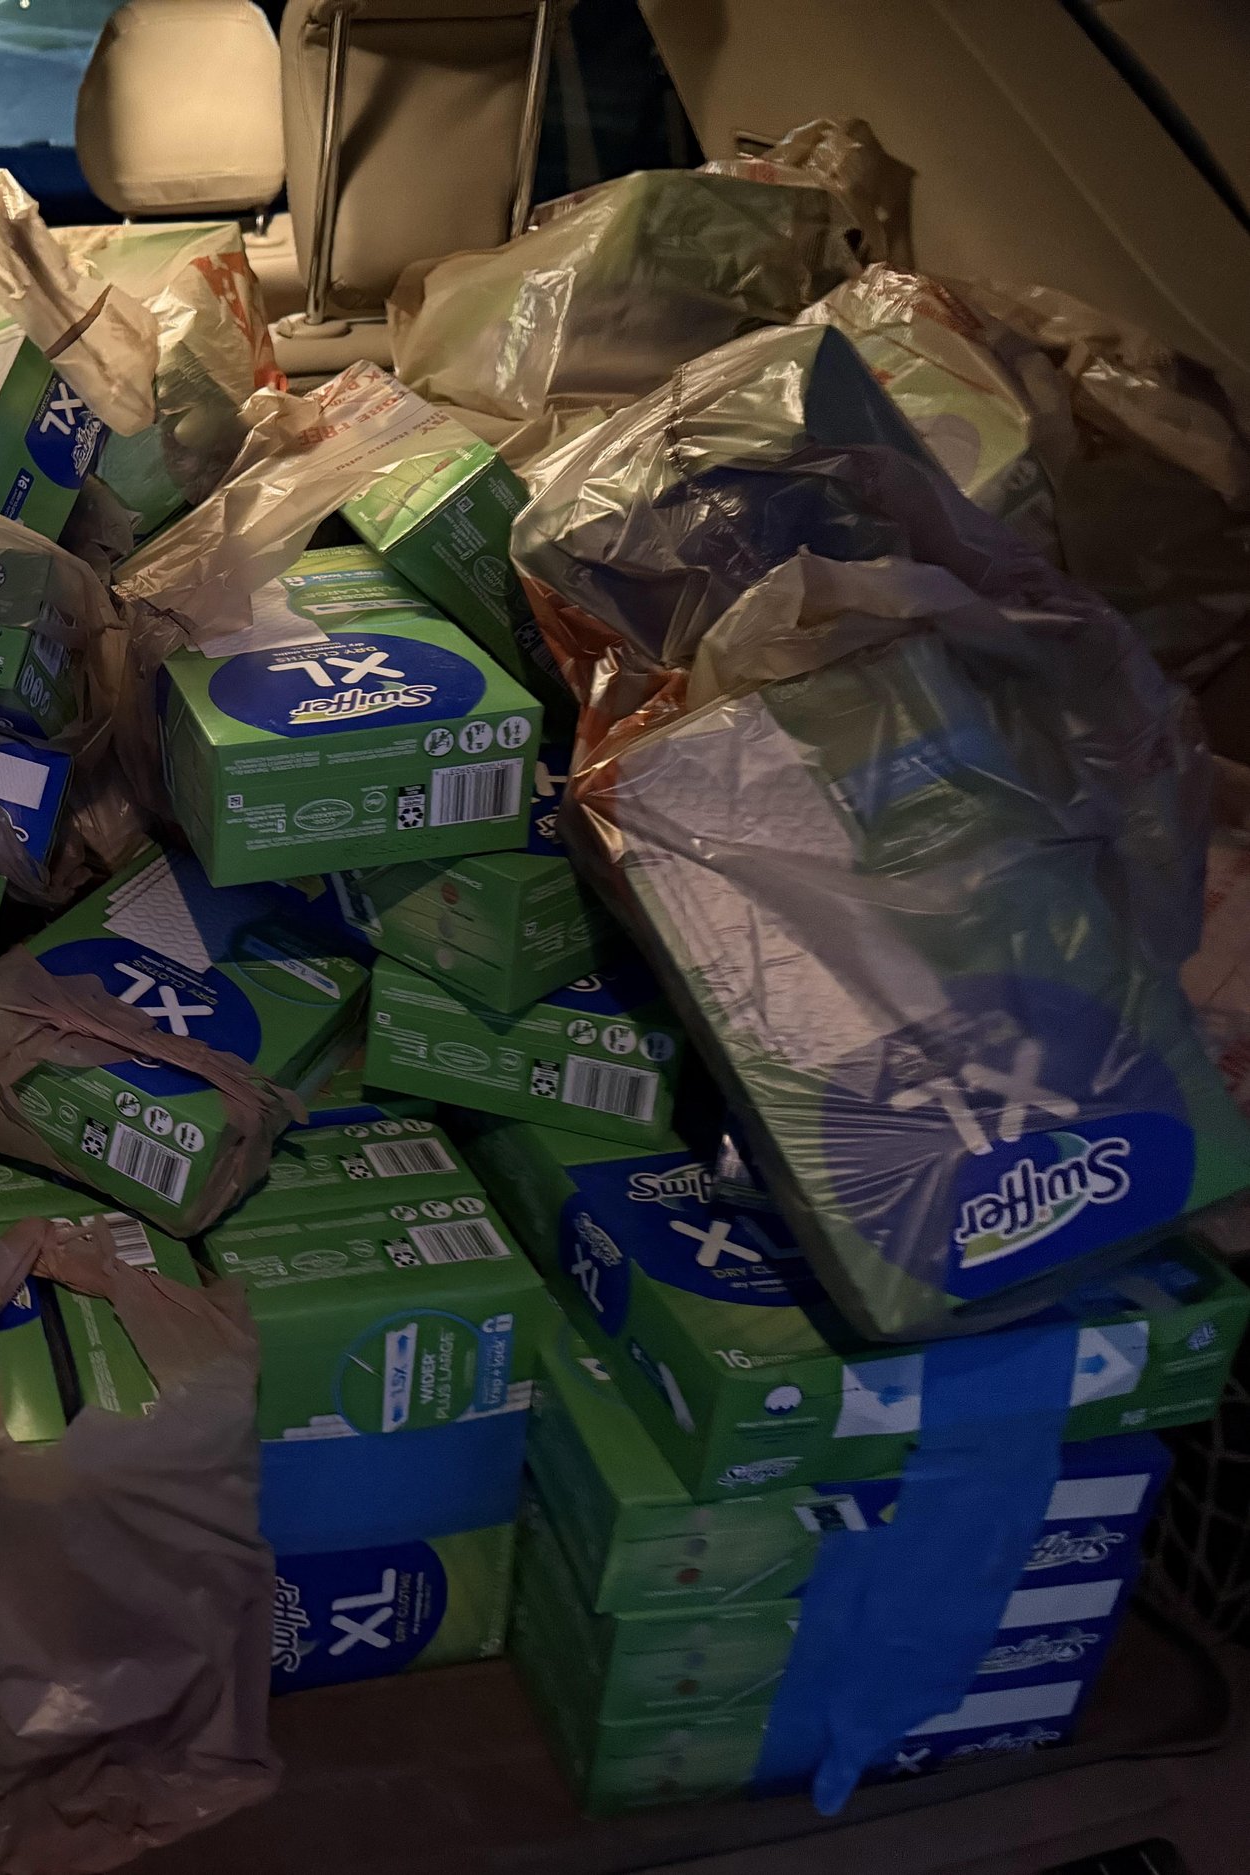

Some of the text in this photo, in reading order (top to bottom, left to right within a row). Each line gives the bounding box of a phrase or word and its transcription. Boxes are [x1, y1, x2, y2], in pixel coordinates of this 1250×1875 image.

[40, 382, 84, 435] XL
[267, 652, 405, 687] XL
[275, 645, 378, 663] DRY CLOTHS
[288, 682, 438, 724] Swiffer
[113, 962, 214, 1036] XL
[131, 959, 187, 989] CLOTHS
[889, 1039, 1079, 1155] XL
[627, 1162, 716, 1211] Swif
[954, 1137, 1131, 1264] Swiffer
[571, 1243, 604, 1313] XL
[420, 1351, 436, 1405] WIDER
[713, 1349, 752, 1369] 16
[328, 1568, 397, 1656] XL
